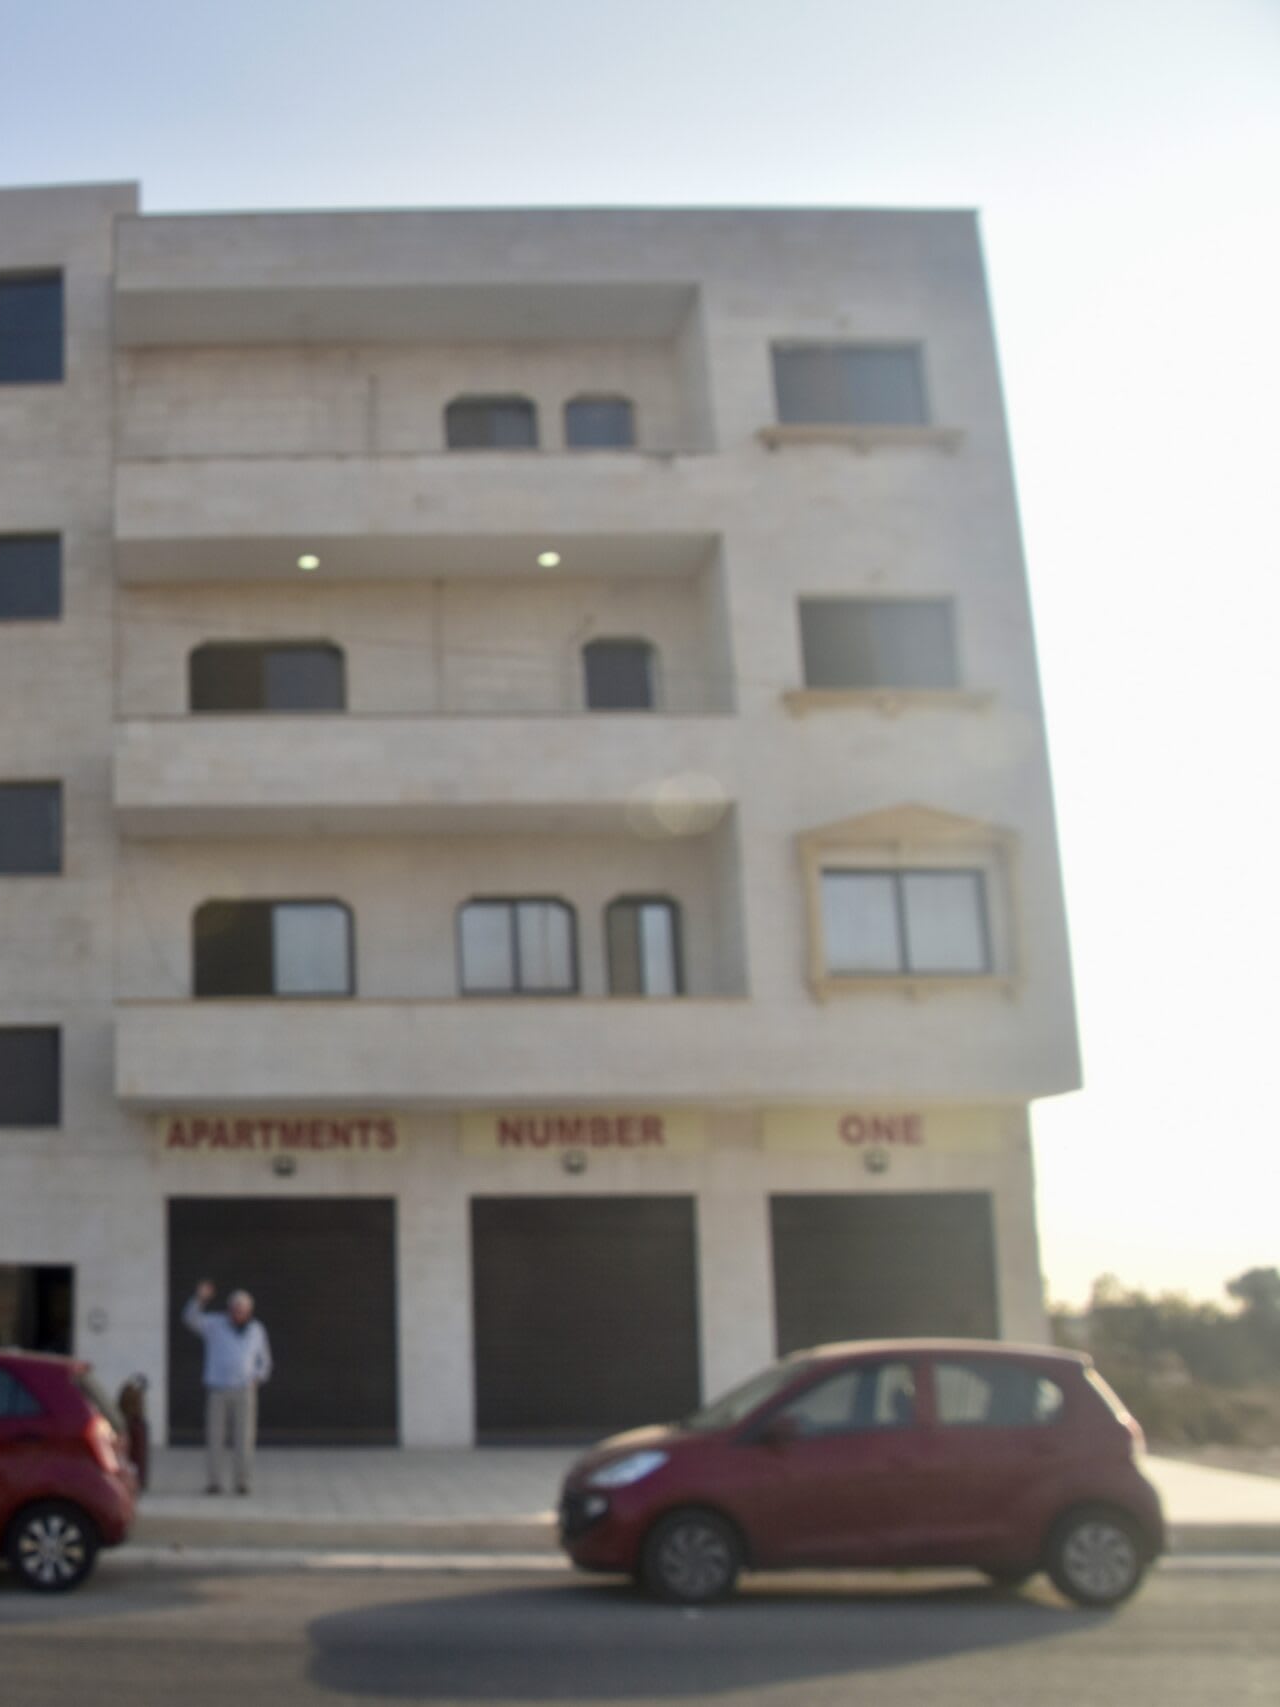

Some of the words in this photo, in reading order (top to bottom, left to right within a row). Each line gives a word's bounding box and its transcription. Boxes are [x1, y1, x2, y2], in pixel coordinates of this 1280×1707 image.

[167, 1119, 397, 1150] APARTMENTS
[498, 1115, 666, 1147] NUMBER
[839, 1114, 923, 1146] ONE
